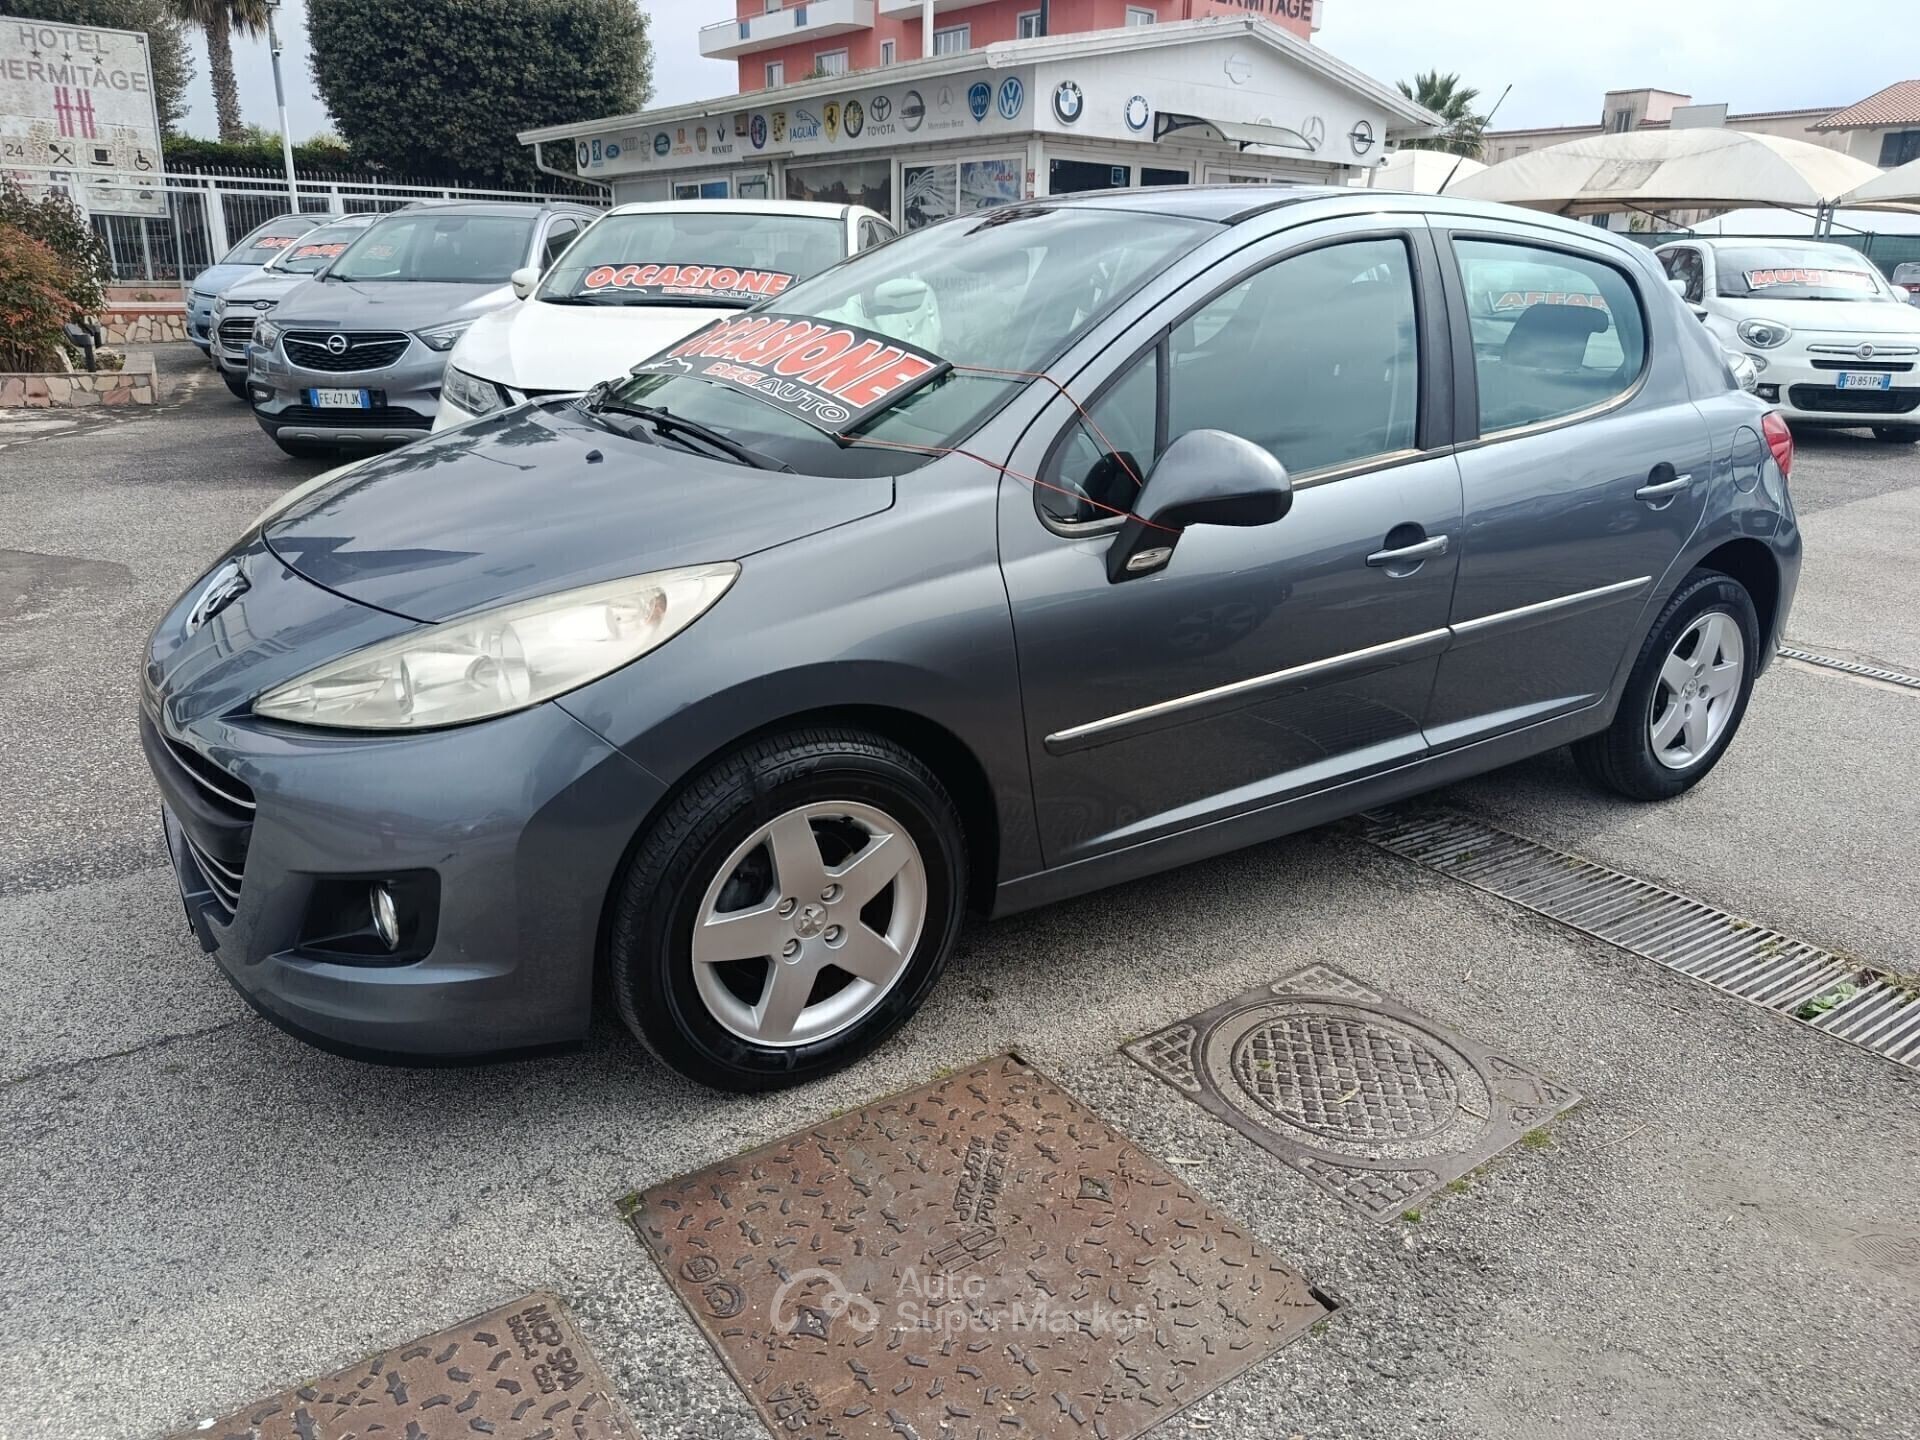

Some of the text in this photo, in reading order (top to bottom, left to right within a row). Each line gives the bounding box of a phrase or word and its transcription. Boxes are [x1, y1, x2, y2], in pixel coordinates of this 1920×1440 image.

[19, 26, 109, 54] HOTEL
[789, 126, 818, 142] JAGUAR
[867, 124, 896, 136] TOYOTA
[6, 144, 24, 157] 24
[994, 172, 1014, 182] Audi
[584, 264, 793, 295] OCCASIONE
[666, 316, 937, 408] OCCASIONE
[702, 361, 850, 423] DEGAUTO
[522, 1304, 585, 1391] MCP SPA
